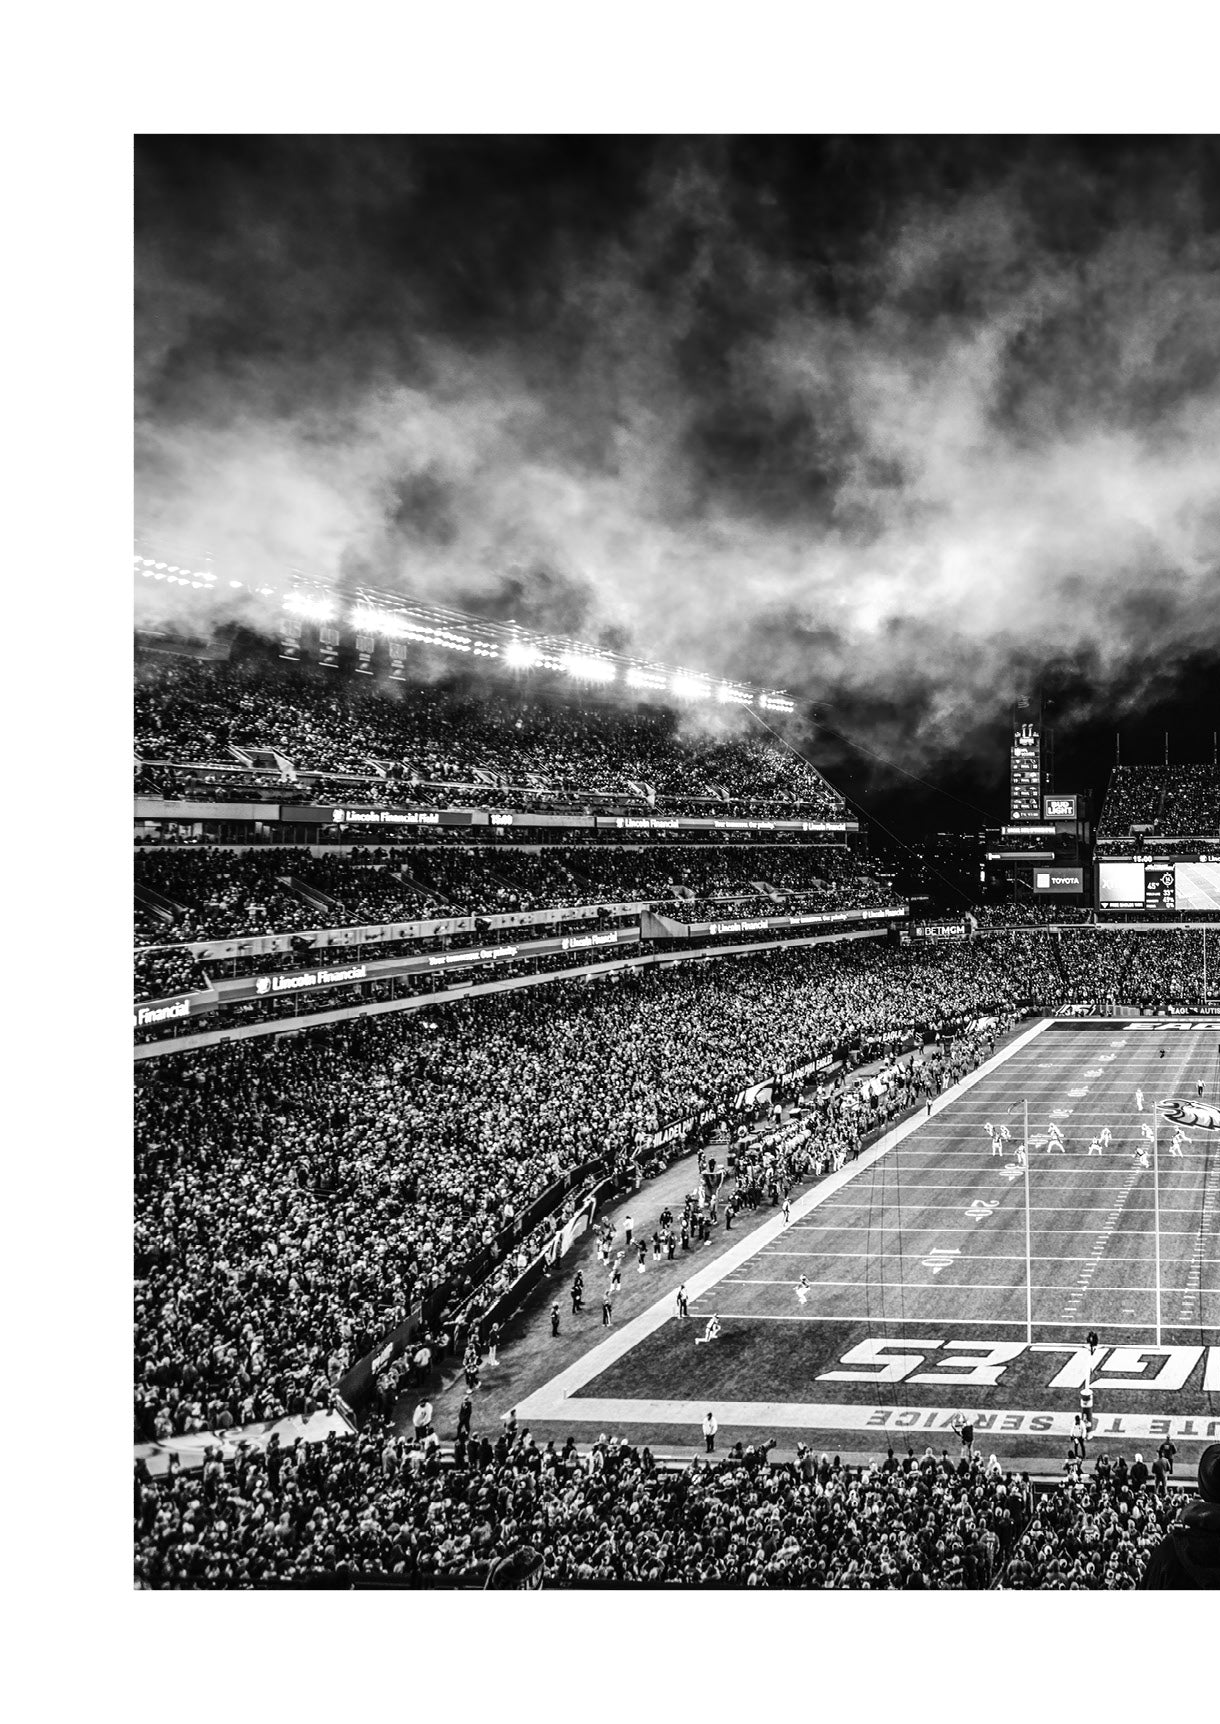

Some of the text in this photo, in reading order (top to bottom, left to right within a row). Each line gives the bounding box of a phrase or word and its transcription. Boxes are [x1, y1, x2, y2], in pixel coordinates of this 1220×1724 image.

[346, 810, 439, 824] Lincoln Financial Field
[1047, 806, 1073, 815] LIGHT
[1051, 877, 1079, 885] TOYOTA
[718, 919, 768, 934] Lincoln Financial
[924, 925, 965, 936] BETMGM
[273, 965, 366, 991] Lincoln Financial
[138, 999, 190, 1025] Financial
[964, 1199, 1000, 1217] 20
[921, 1247, 962, 1267] 10
